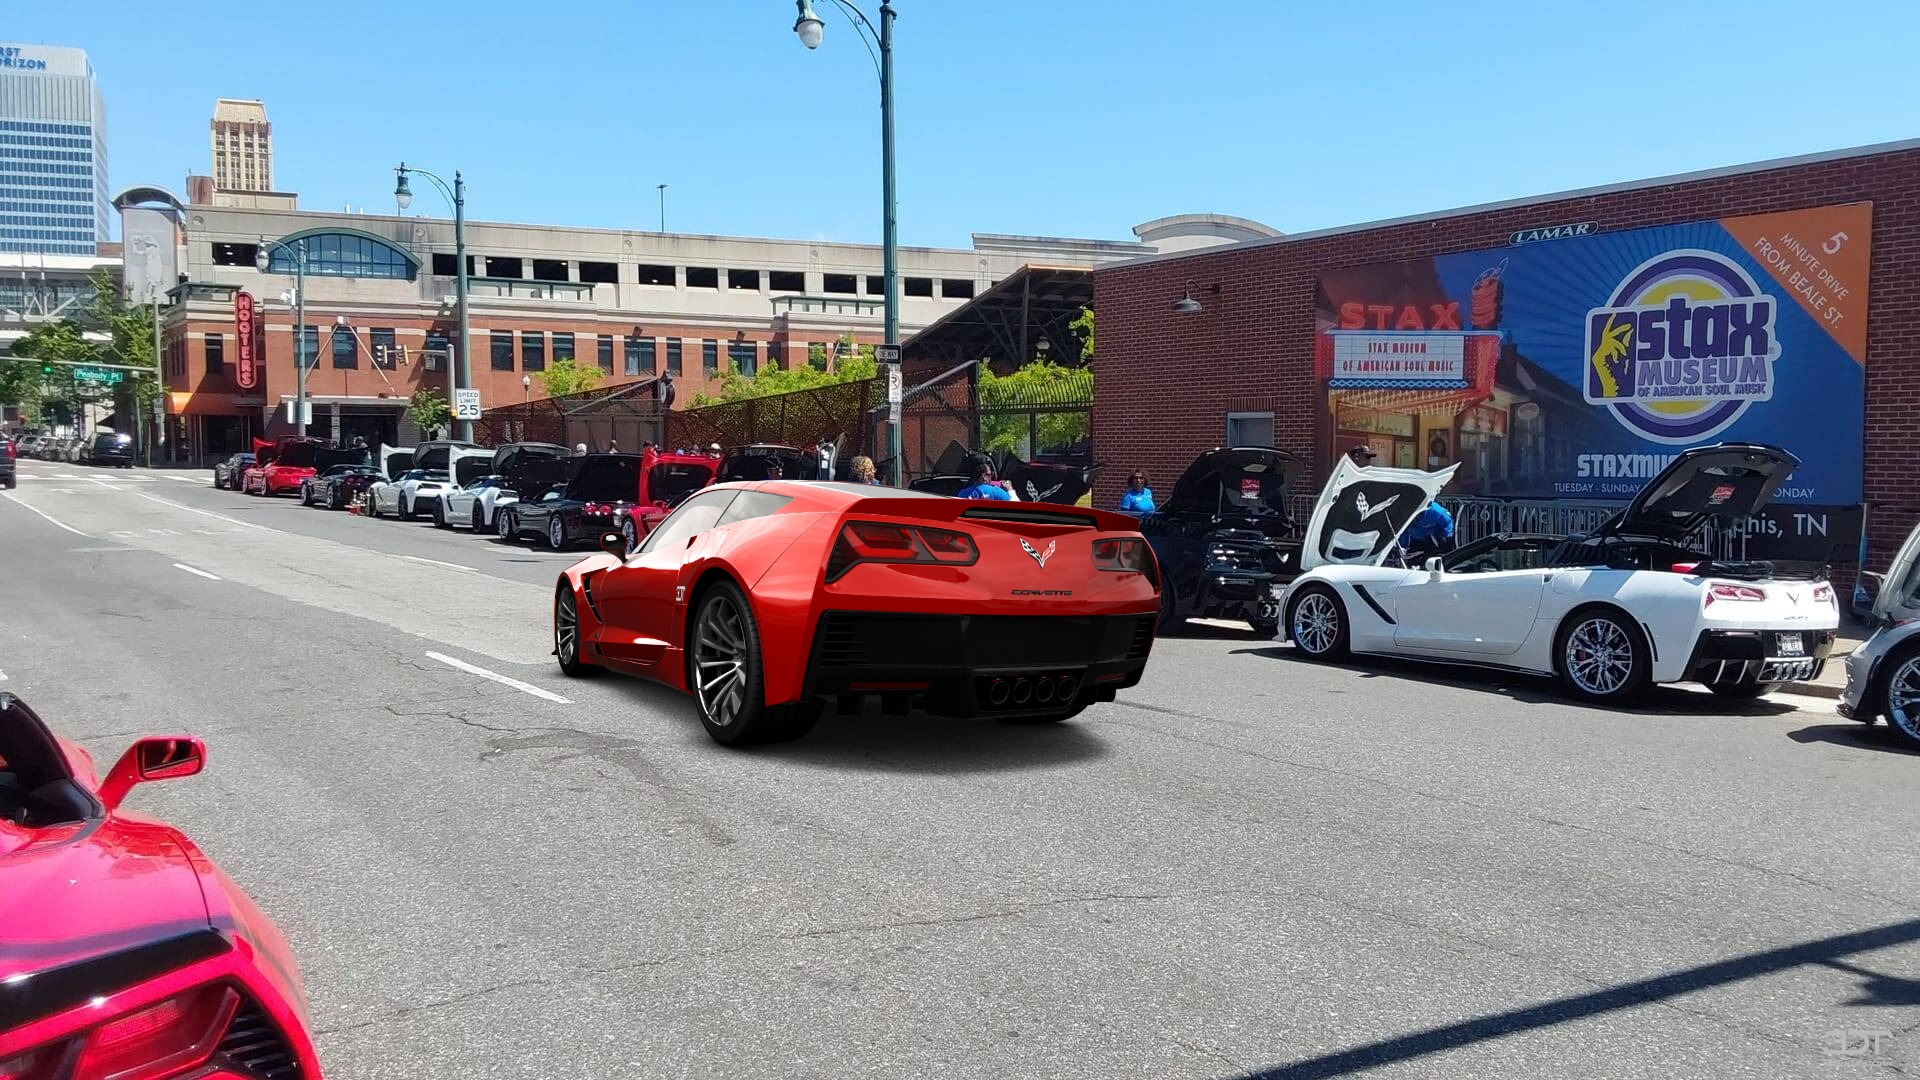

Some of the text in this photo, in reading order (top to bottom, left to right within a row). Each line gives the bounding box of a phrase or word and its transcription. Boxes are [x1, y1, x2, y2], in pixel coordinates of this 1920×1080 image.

[0, 58, 46, 69] RIZON
[1516, 224, 1590, 242] LAMAR
[1823, 231, 1849, 254] 5
[1780, 233, 1849, 300] MINUTE DRIVE
[1754, 236, 1844, 328] FROM BEALE ST.
[1341, 302, 1460, 330] STAX
[1637, 298, 1770, 361] stax
[238, 296, 252, 385] HOOTERS
[1368, 342, 1427, 354] STAX MUSEUM
[76, 369, 107, 380] Peabody
[1342, 360, 1454, 372] OF AMERICAN SOUL MUSIC
[1637, 357, 1768, 386] MUSEUM
[1637, 383, 1766, 397] OF AMERICAN SOUL MUSIC
[459, 404, 479, 416] 25
[1577, 454, 1679, 478] STAXMU
[1553, 483, 1594, 493] TUESDAY
[1600, 484, 1640, 493] SUNDAY
[1772, 487, 1815, 498] ONDAY
[1793, 513, 1828, 537] TN
